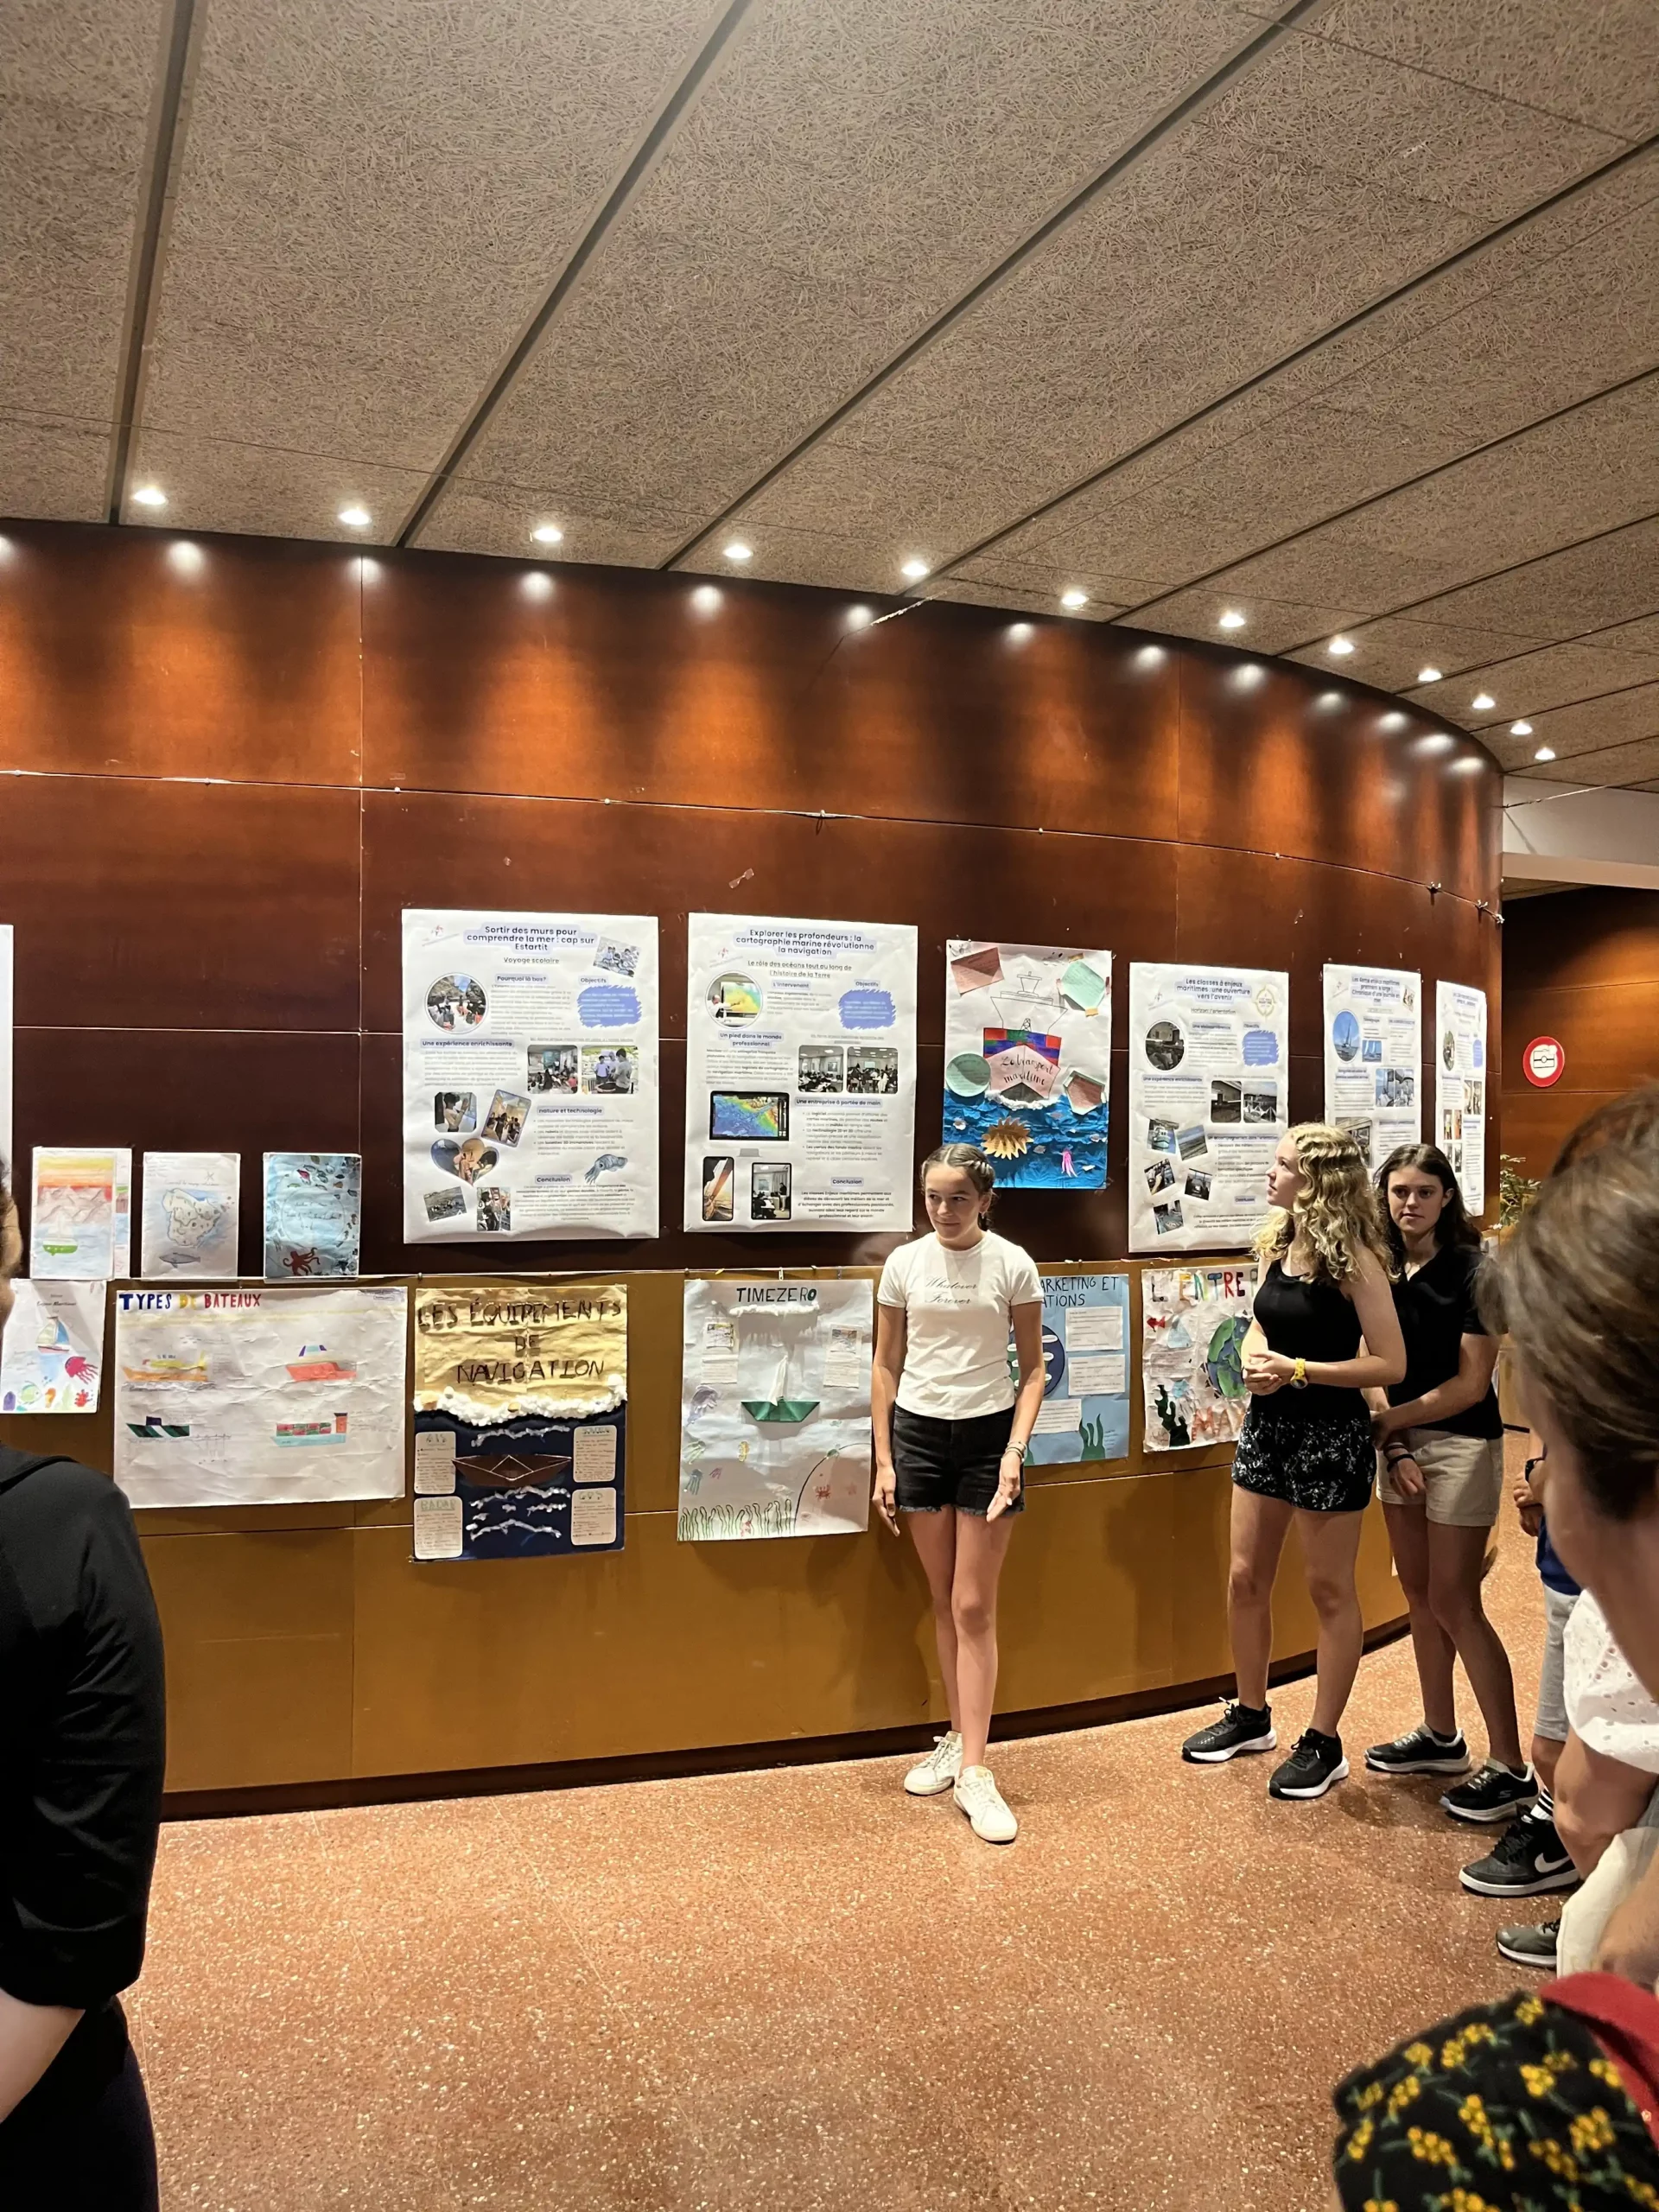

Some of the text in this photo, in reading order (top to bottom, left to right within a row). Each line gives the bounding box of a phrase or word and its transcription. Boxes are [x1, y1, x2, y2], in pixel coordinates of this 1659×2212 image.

[467, 934, 524, 943] comprendre
[799, 931, 848, 941] profondeurs
[736, 938, 791, 946] cartographie
[823, 940, 874, 950] révolutionne
[787, 947, 832, 956] navigation
[925, 1275, 977, 1289] Whatever
[1102, 1276, 1119, 1290] ET
[736, 1287, 817, 1302] TIMEZERO
[925, 1292, 971, 1304] Forever
[119, 1294, 171, 1310] TYPES
[205, 1294, 261, 1308] BATEAUX
[457, 1360, 604, 1384] NAVIGATION
